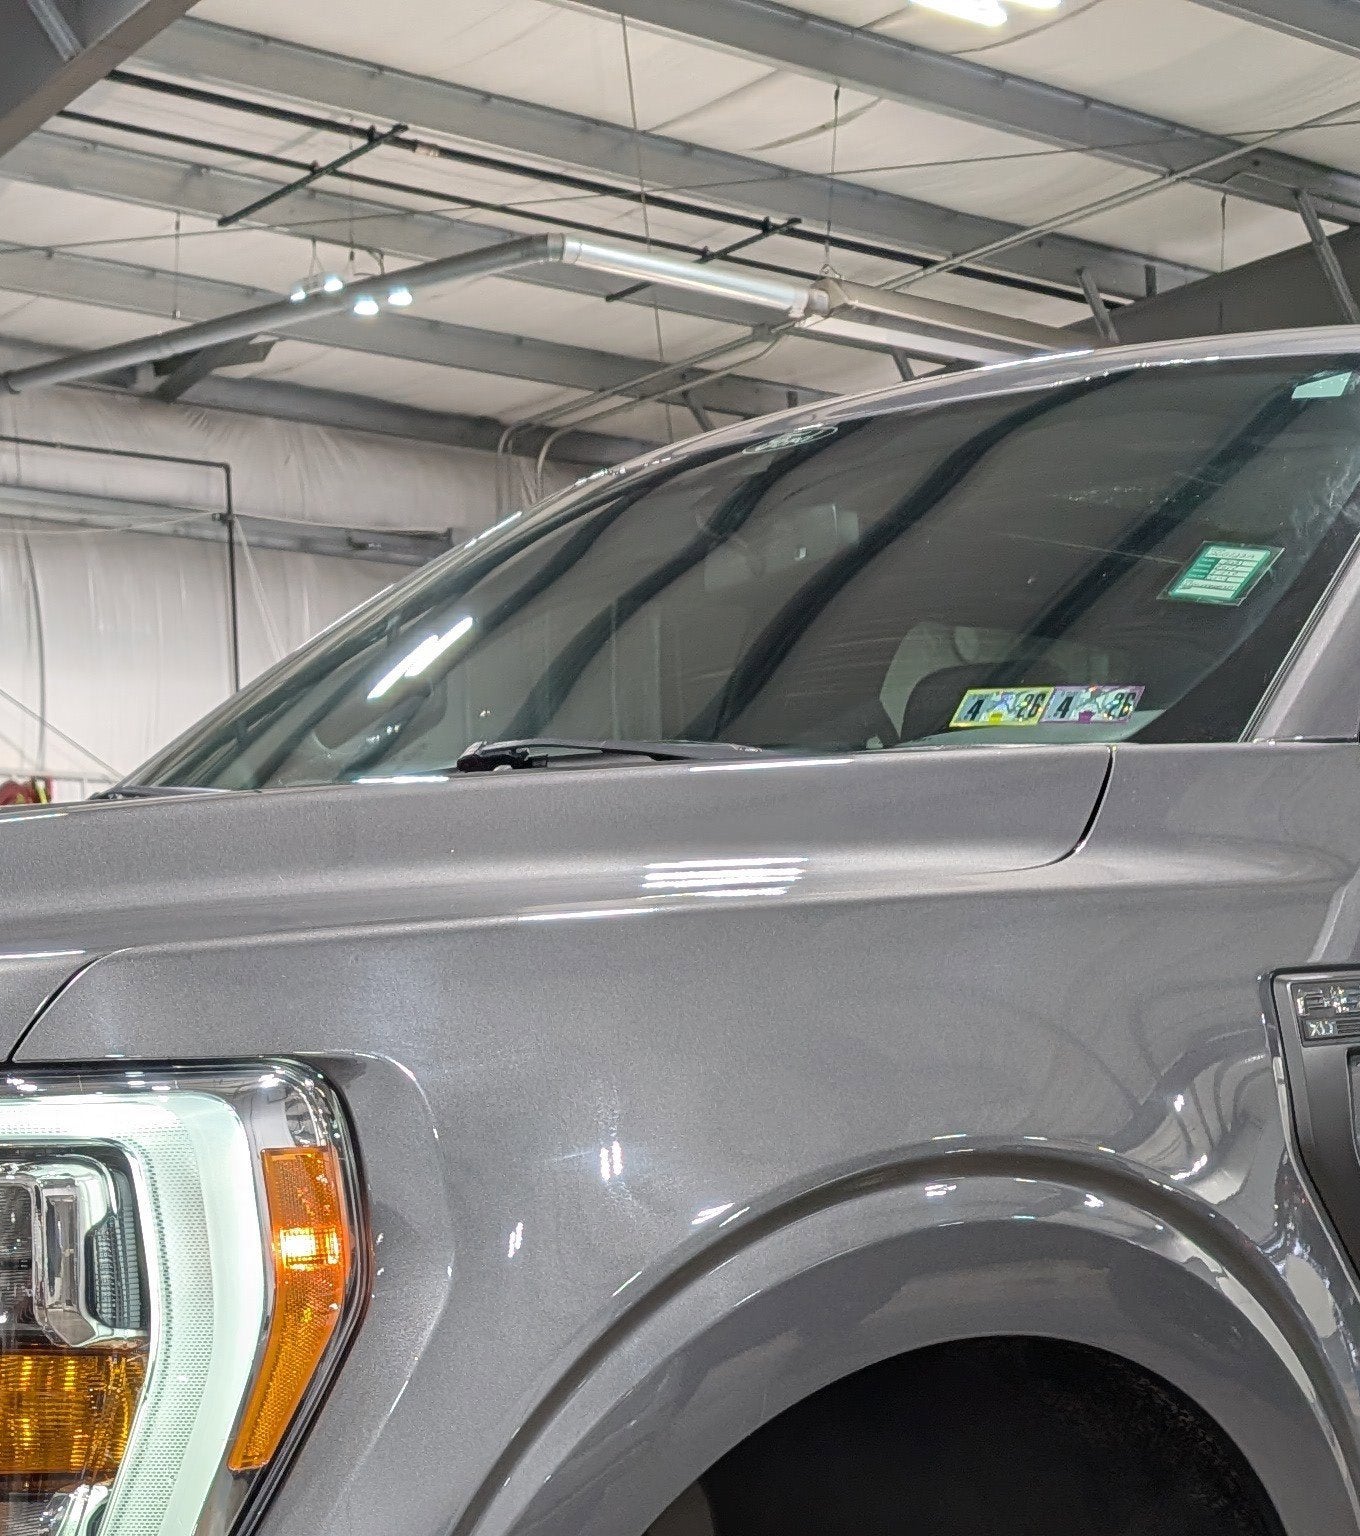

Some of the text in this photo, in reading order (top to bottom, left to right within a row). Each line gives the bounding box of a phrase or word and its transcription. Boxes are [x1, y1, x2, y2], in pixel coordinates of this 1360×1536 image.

[967, 693, 1046, 721] 4 26
[1055, 696, 1073, 718] 4
